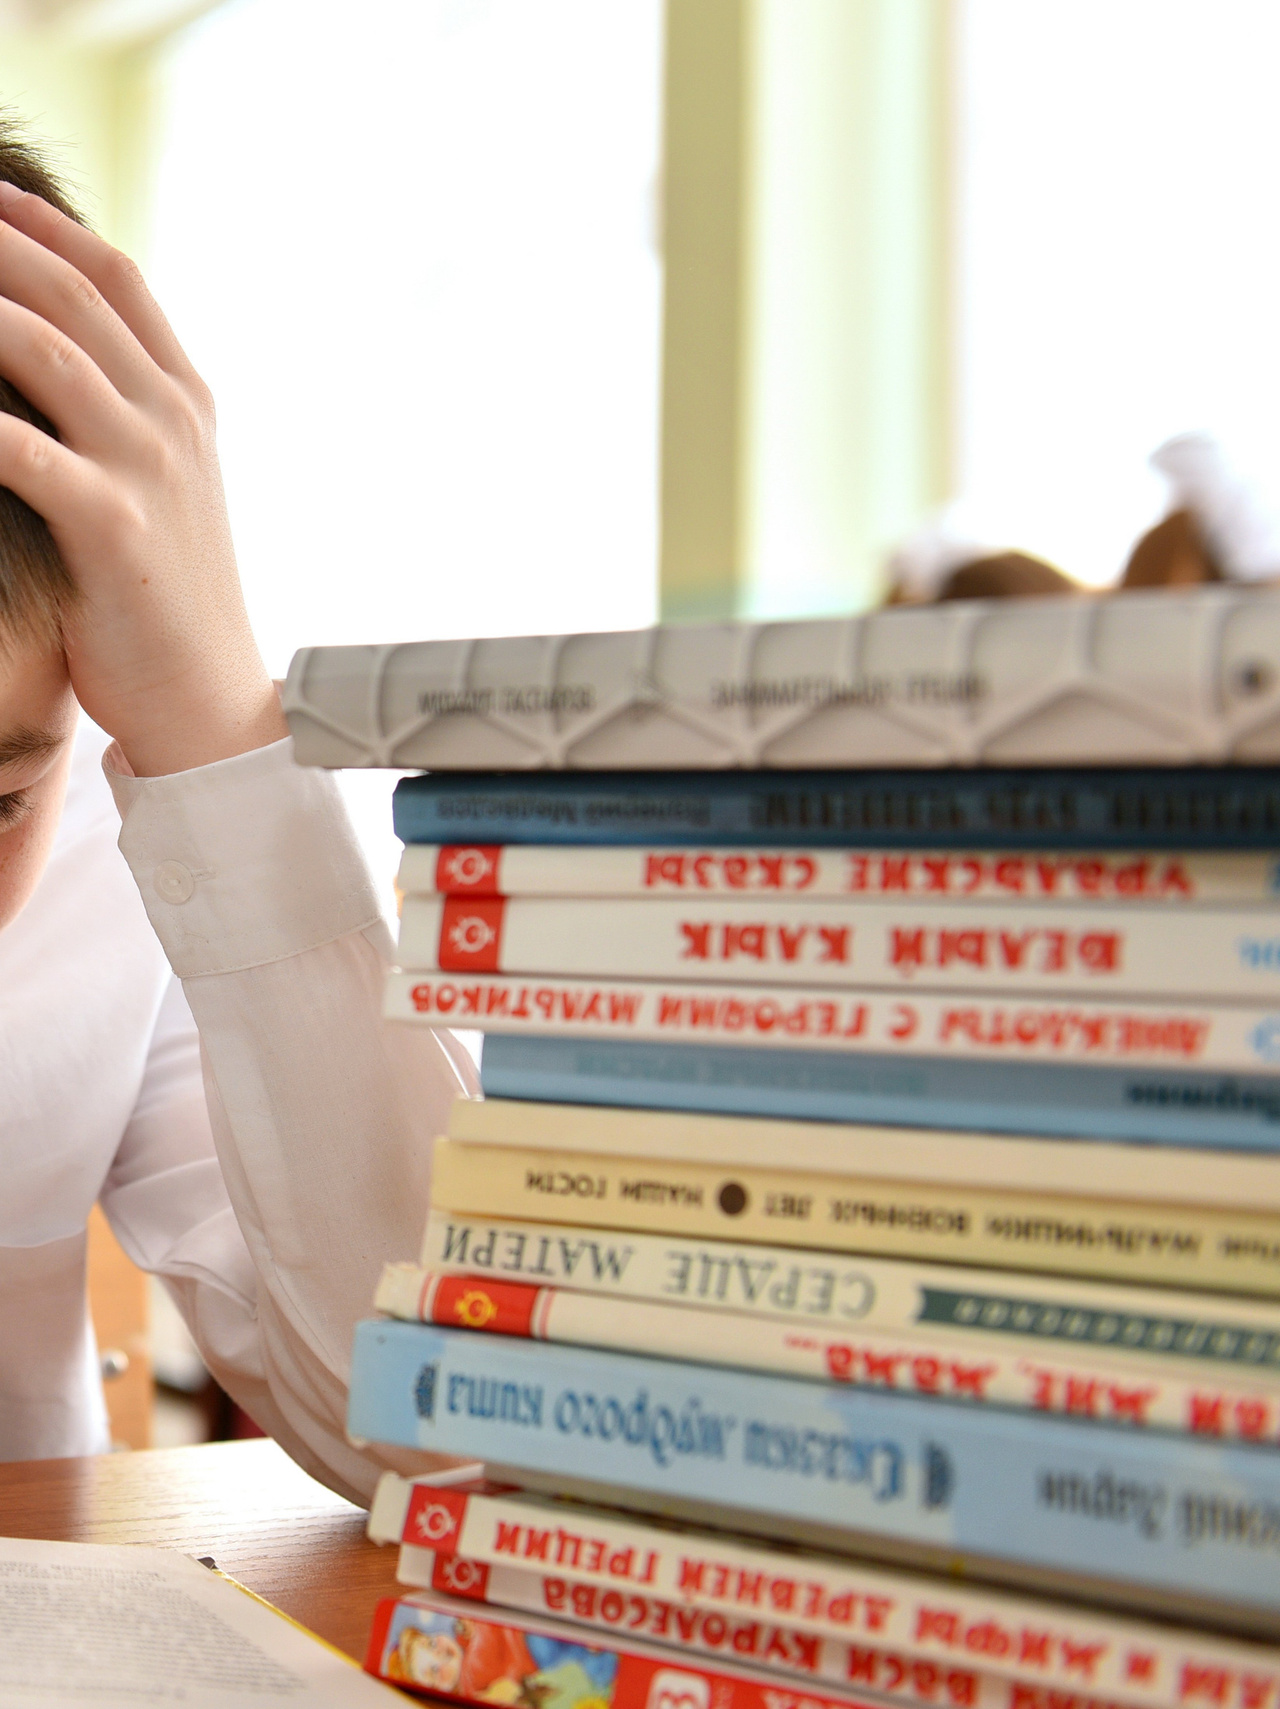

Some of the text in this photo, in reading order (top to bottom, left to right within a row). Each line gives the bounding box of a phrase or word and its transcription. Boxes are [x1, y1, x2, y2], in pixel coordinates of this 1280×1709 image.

[643, 852, 817, 892] СКАЗЫ
[676, 921, 1122, 979] БЕЛЫЙ КЛЫК
[409, 983, 643, 1028] МУЛЬТИКОВ
[654, 995, 869, 1039] ГЕРОЯМИ
[888, 1005, 919, 1041] С
[938, 1009, 1210, 1060] АНЕКДОТЫ
[524, 1169, 705, 1209] НАШИ ГОСТИ
[438, 1222, 878, 1321] СЕРДЦЕ МАТЕРИ
[446, 1372, 906, 1505] Сказки мудрого кита
[493, 1519, 662, 1588] ГРЕЦИИ
[678, 1556, 892, 1637] ДРЕВНЕЙ
[542, 1576, 823, 1675] КУРОЛЕСОВА
